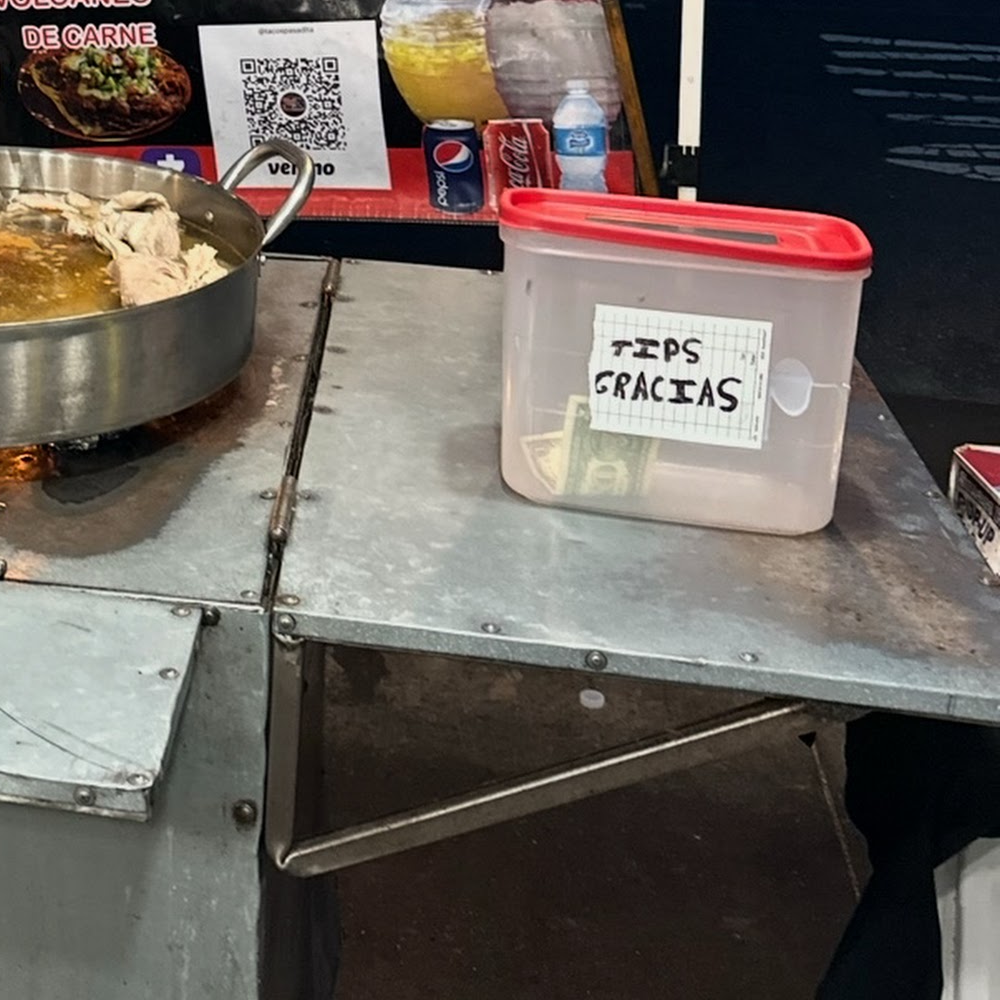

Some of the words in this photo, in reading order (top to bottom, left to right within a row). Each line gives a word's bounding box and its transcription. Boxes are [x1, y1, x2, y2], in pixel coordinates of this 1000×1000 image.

[21, 25, 61, 49] DE
[62, 22, 156, 49] CARNE
[611, 338, 703, 364] TIPS
[594, 371, 743, 413] GRACIAS
